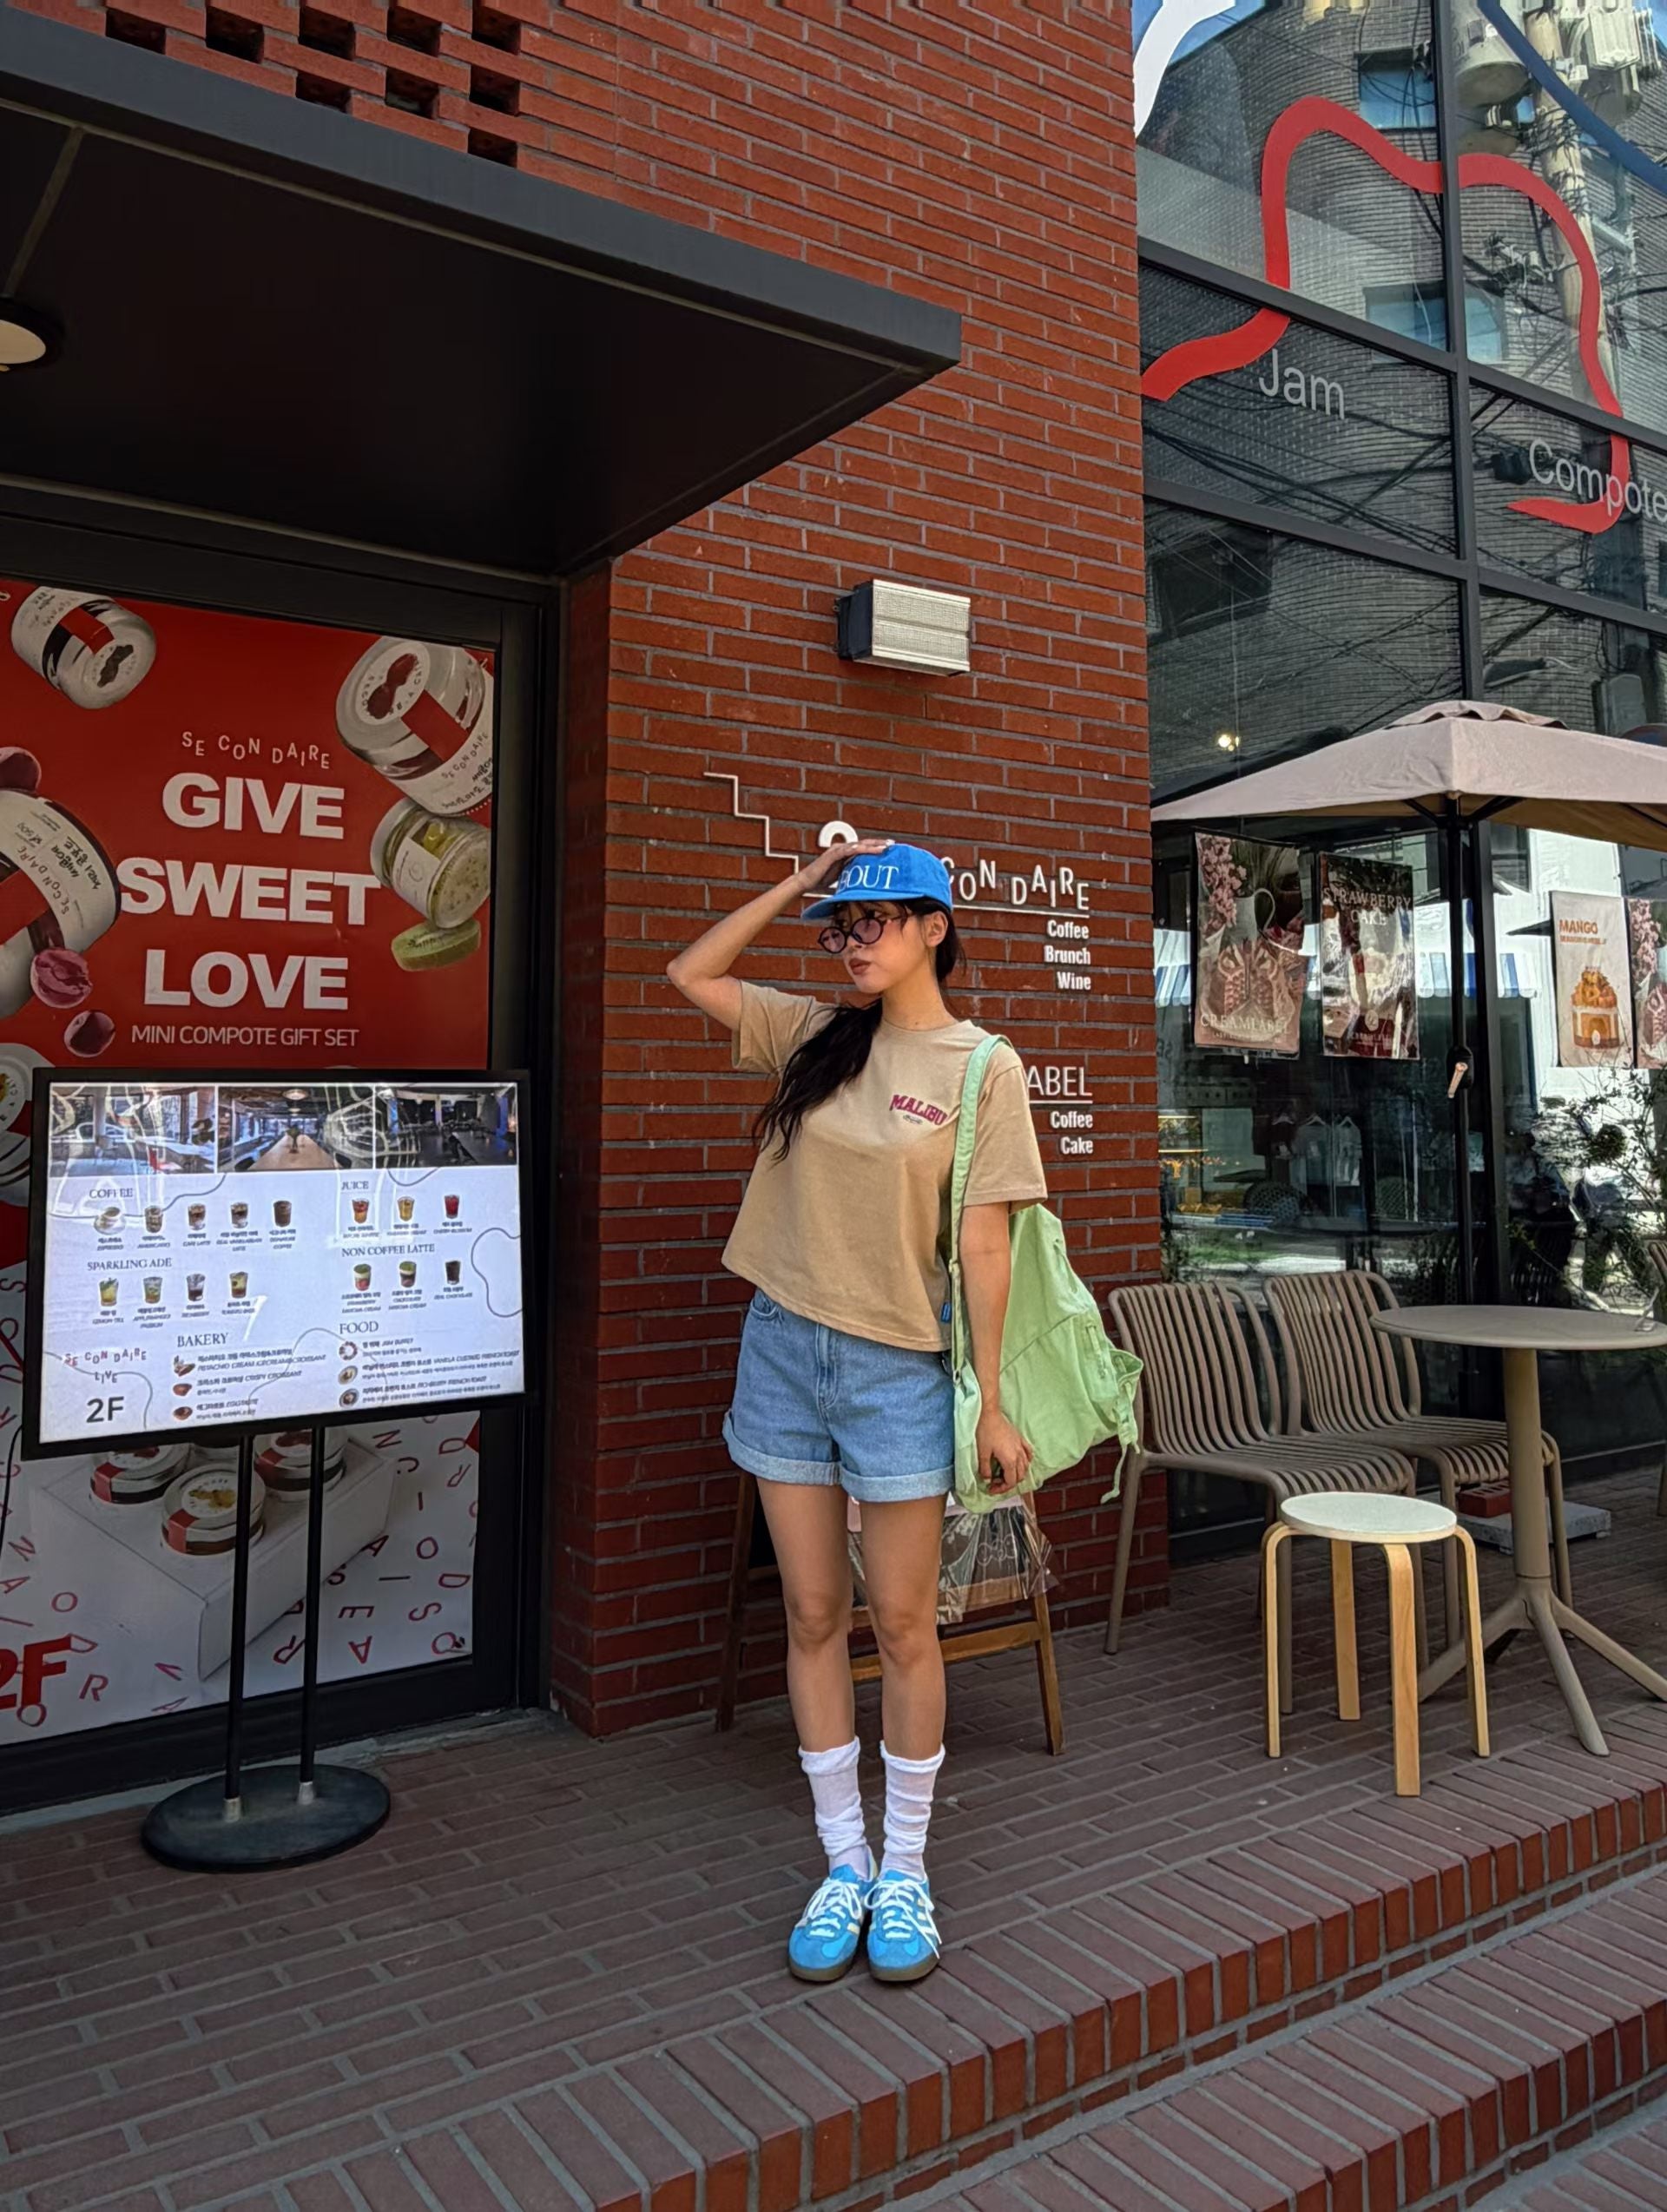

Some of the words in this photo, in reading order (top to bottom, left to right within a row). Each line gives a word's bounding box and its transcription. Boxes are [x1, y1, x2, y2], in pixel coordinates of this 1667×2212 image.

[1259, 348, 1344, 420] Jam
[1529, 438, 1667, 523] Compote
[162, 772, 345, 839] GIVE
[116, 856, 382, 926] SWEET
[1011, 864, 1090, 911] DAIRE
[1323, 885, 1412, 912] STRAWBERRY
[1350, 909, 1387, 926] CAKE
[1559, 919, 1598, 935] MANGO
[1046, 919, 1090, 939] Coffee
[1044, 945, 1091, 965] Brunch
[144, 949, 348, 1011] LOVE
[1056, 971, 1091, 991] Wine
[131, 1024, 175, 1043] MINI
[179, 1025, 278, 1045] COMPOTE
[280, 1028, 322, 1047] GIFT
[324, 1029, 359, 1047] SET
[889, 1094, 948, 1126] MALIBU
[1050, 1110, 1094, 1129] Coffee
[1060, 1136, 1094, 1155] Cake
[89, 1188, 134, 1199] COFFEE
[341, 1181, 369, 1191] JUICE
[341, 1248, 366, 1257] NON
[367, 1245, 405, 1256] COFFEE
[406, 1244, 435, 1254] LATTE
[87, 1259, 148, 1271] SPARKLING
[148, 1257, 172, 1268] ADE
[339, 1320, 379, 1334] FOOD
[177, 1332, 228, 1347] BAKERY
[95, 1370, 117, 1384] LIVE
[86, 1396, 125, 1424] 2F
